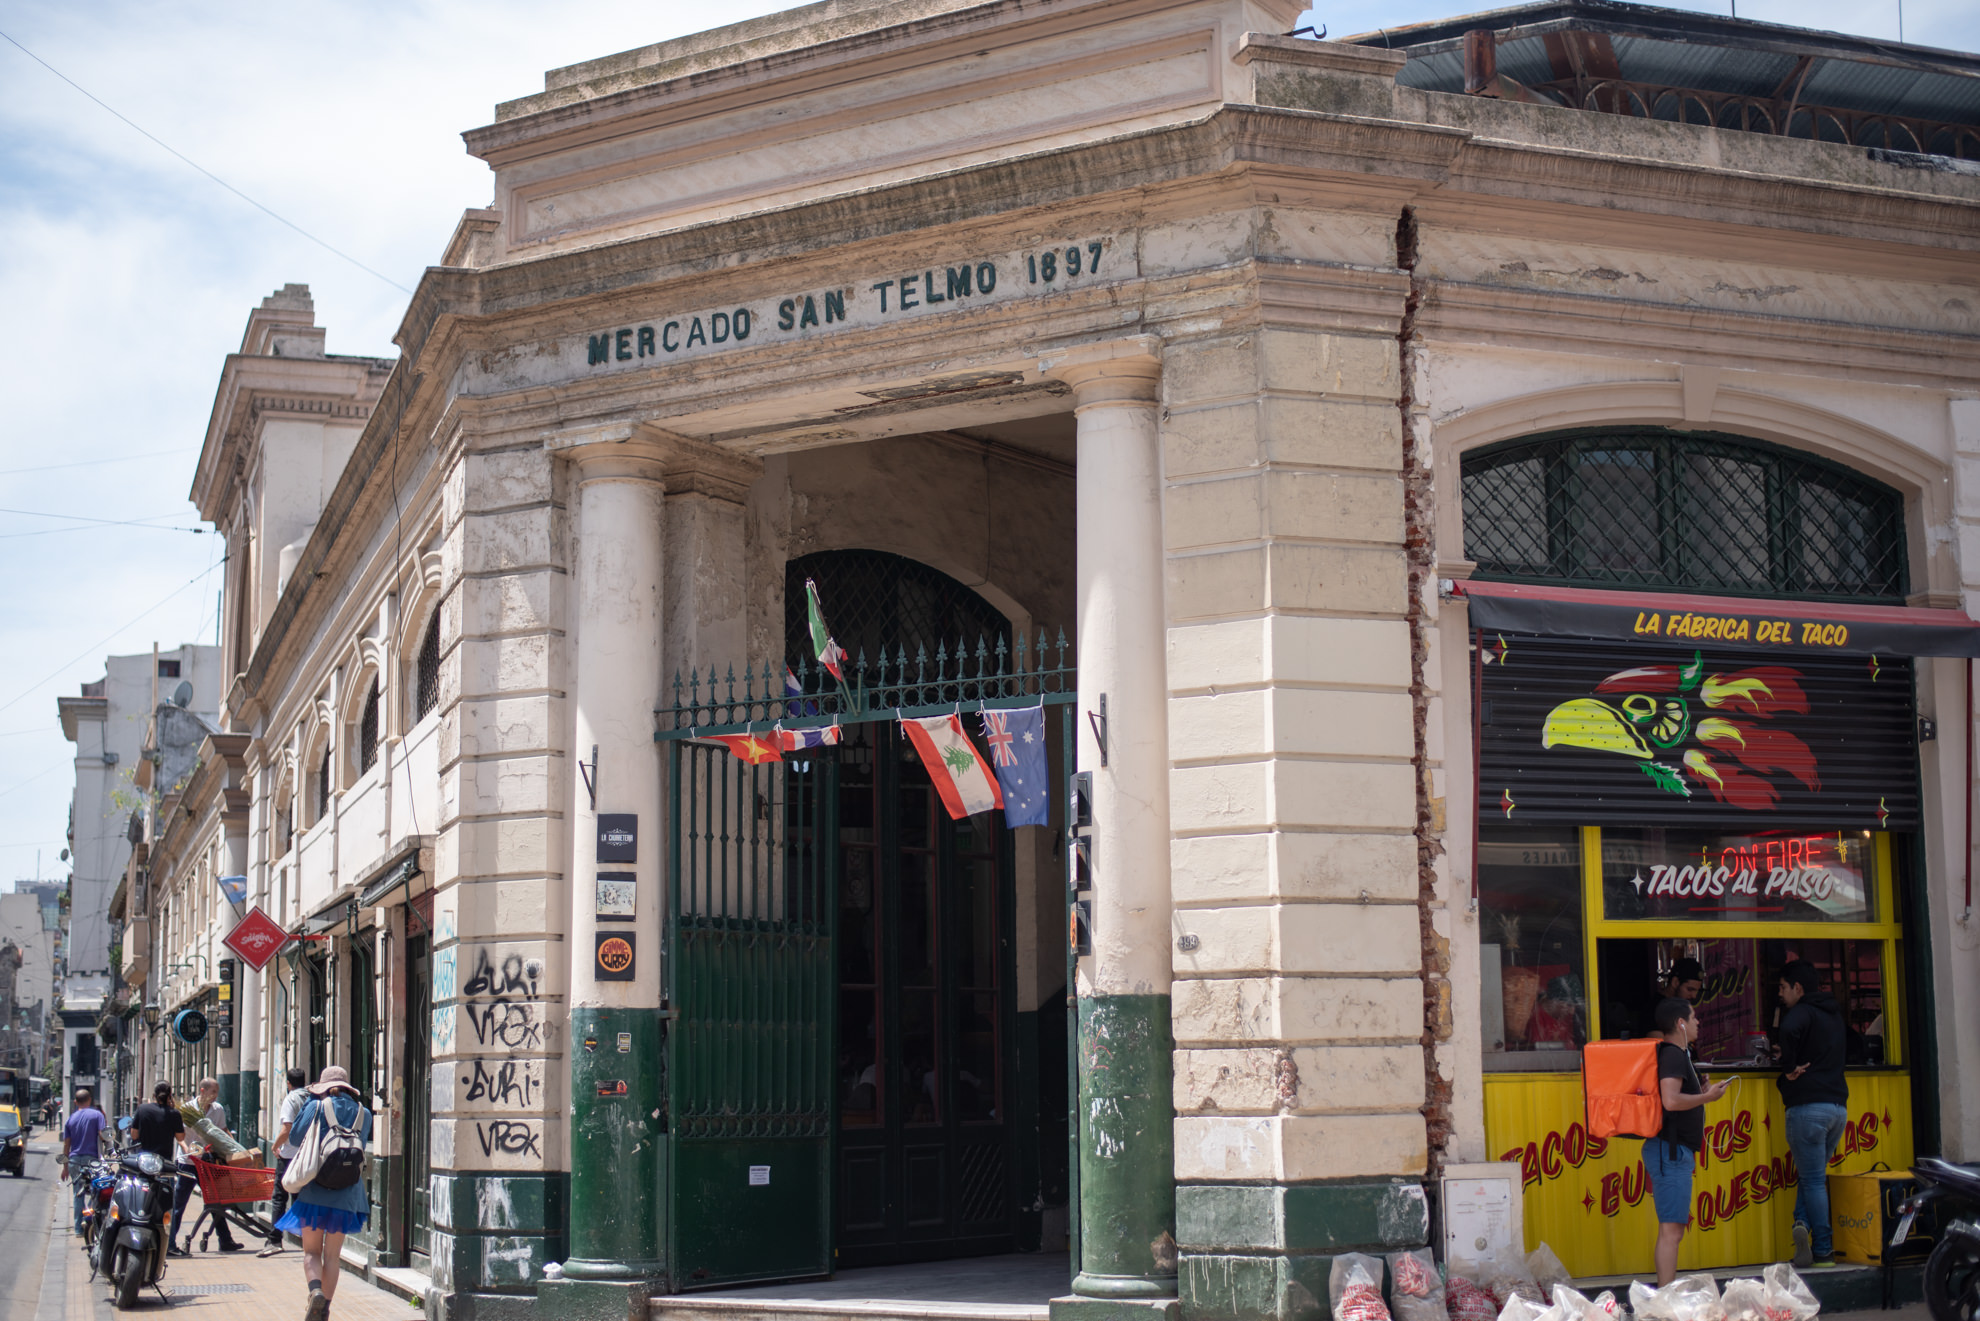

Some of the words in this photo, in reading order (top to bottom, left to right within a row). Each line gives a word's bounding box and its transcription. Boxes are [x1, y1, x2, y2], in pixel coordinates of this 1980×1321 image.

[587, 308, 751, 366] MERCADO
[778, 290, 846, 331] SAN
[872, 261, 997, 314] TELMO
[1028, 242, 1103, 285] 1897
[1634, 611, 1661, 635] LA
[1666, 612, 1750, 641] FÁBRICA
[1755, 620, 1793, 644] DEL
[1801, 622, 1849, 647] TACO
[1720, 843, 1758, 877] ON
[1766, 837, 1824, 873] FIRE
[1647, 864, 1730, 898] TACOS
[1732, 868, 1759, 896] AL
[1764, 866, 1834, 899] PASO
[1837, 1213, 1869, 1230] Glovo
